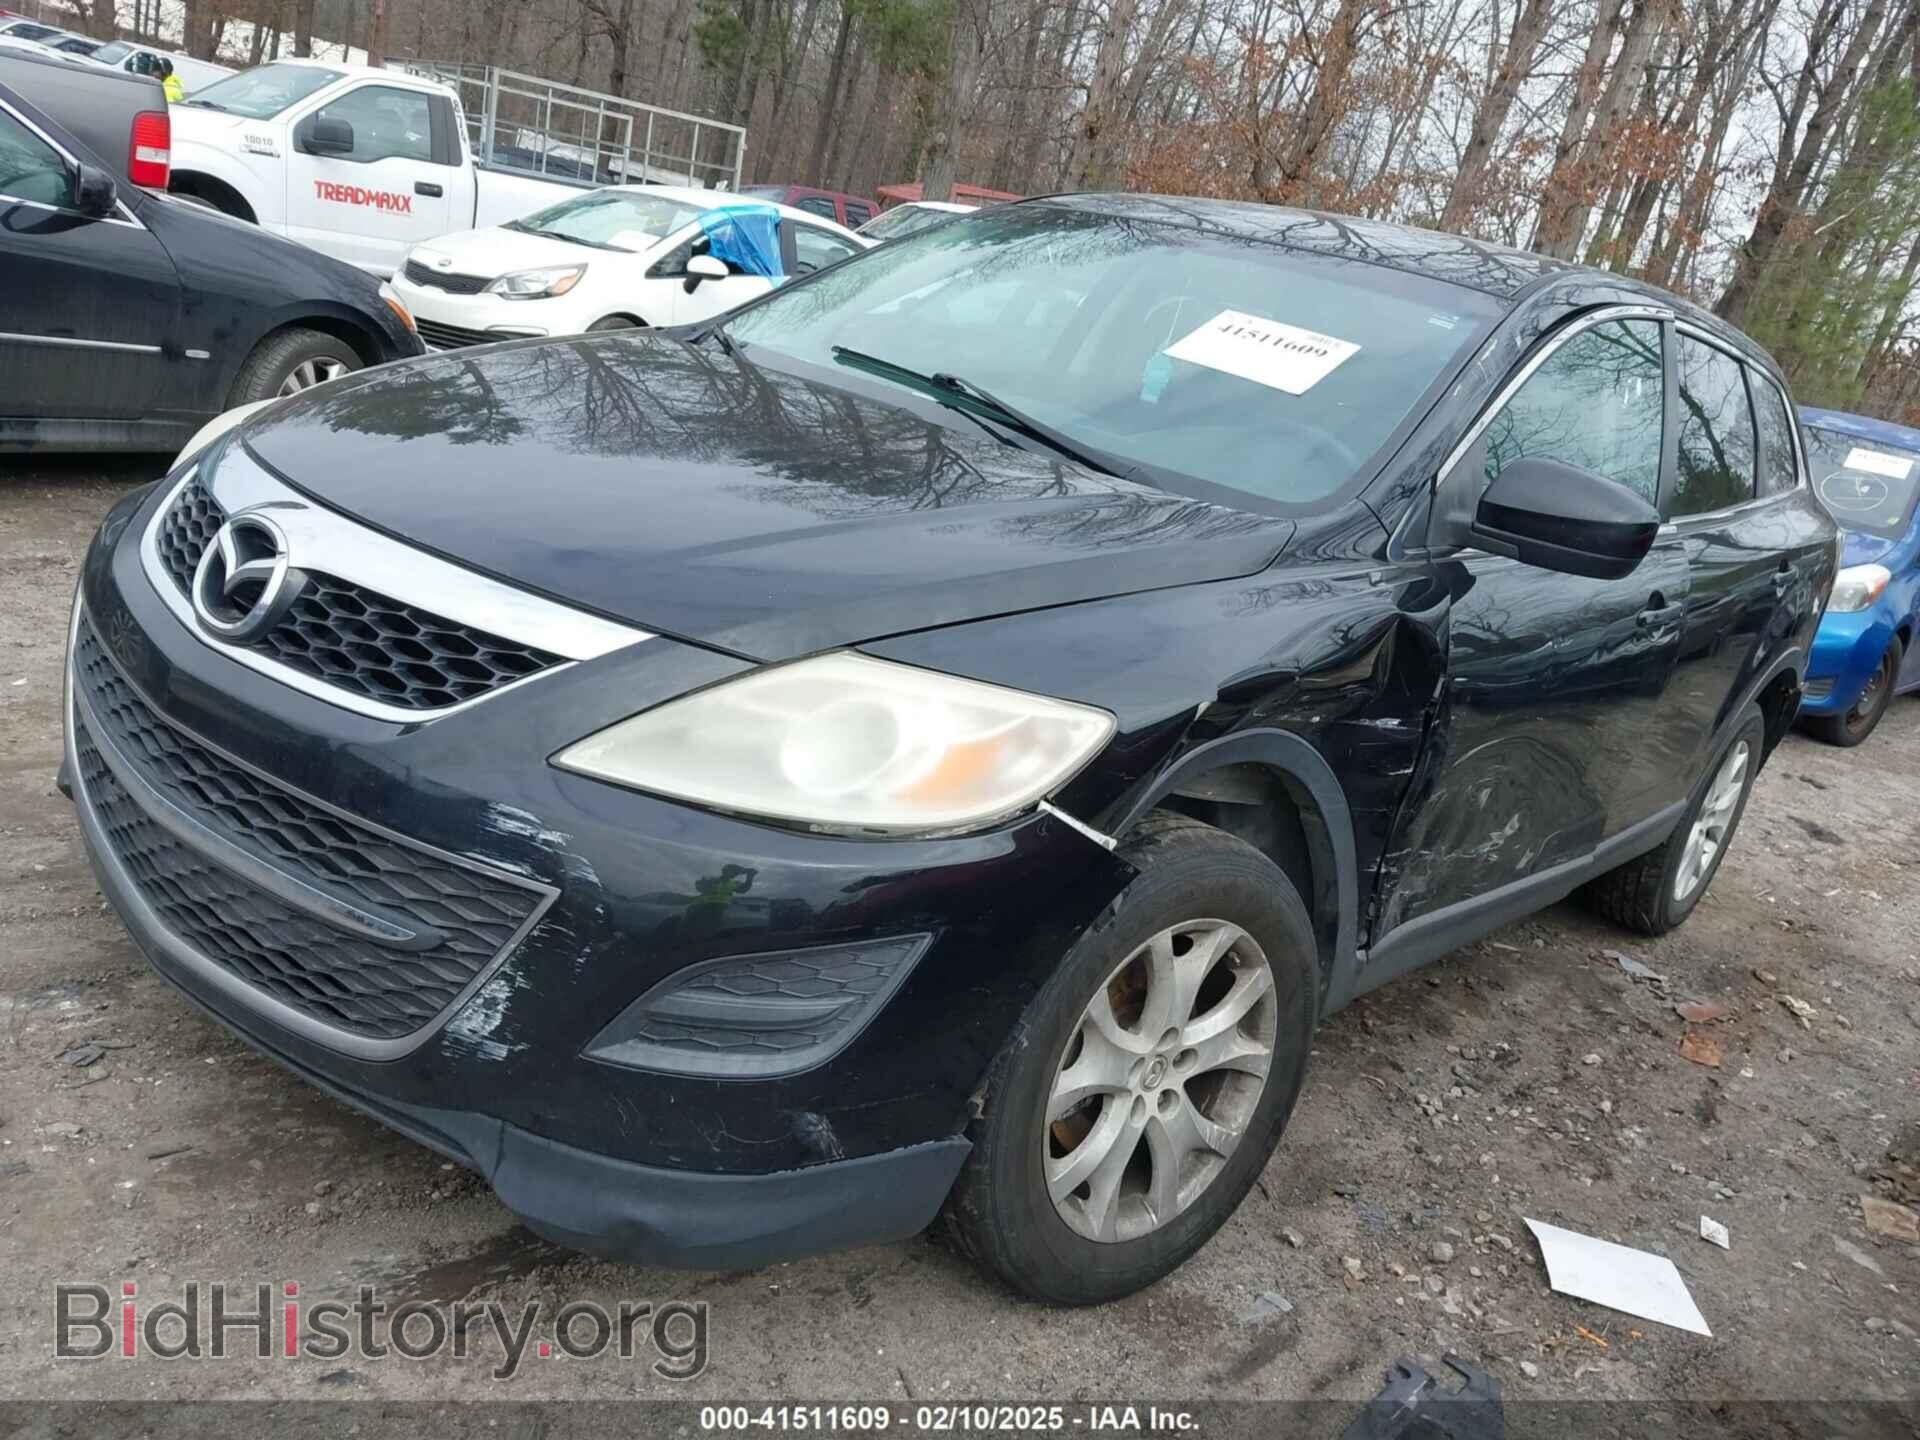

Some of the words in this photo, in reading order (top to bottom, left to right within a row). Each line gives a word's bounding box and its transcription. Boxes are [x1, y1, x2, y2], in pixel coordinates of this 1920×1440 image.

[243, 134, 274, 146] 10010
[313, 180, 411, 213] TREADMAXX
[1217, 324, 1329, 358] 41511609
